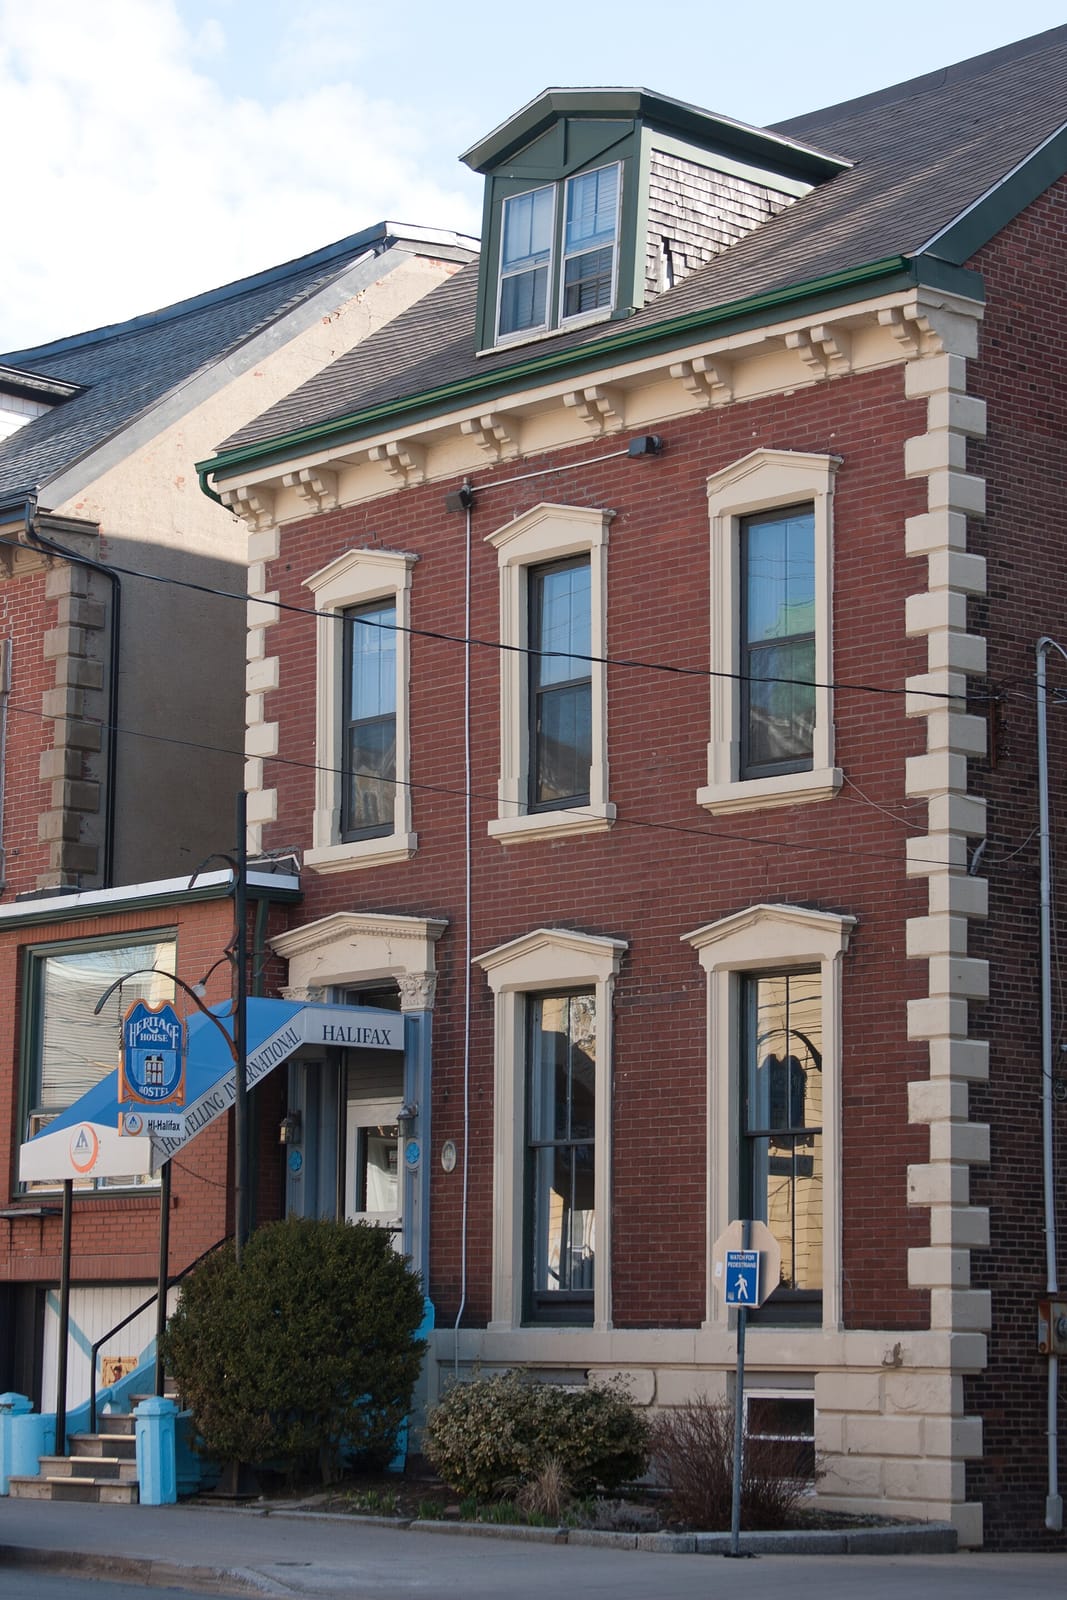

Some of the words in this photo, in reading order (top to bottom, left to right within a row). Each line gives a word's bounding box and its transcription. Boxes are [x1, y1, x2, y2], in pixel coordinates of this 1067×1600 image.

[129, 1016, 179, 1049] HERITAGE
[140, 1032, 169, 1043] HOUSE
[322, 1024, 391, 1046] HALIFAX
[138, 1086, 169, 1098] HOSTEL
[147, 1119, 181, 1132] HI-Halifax
